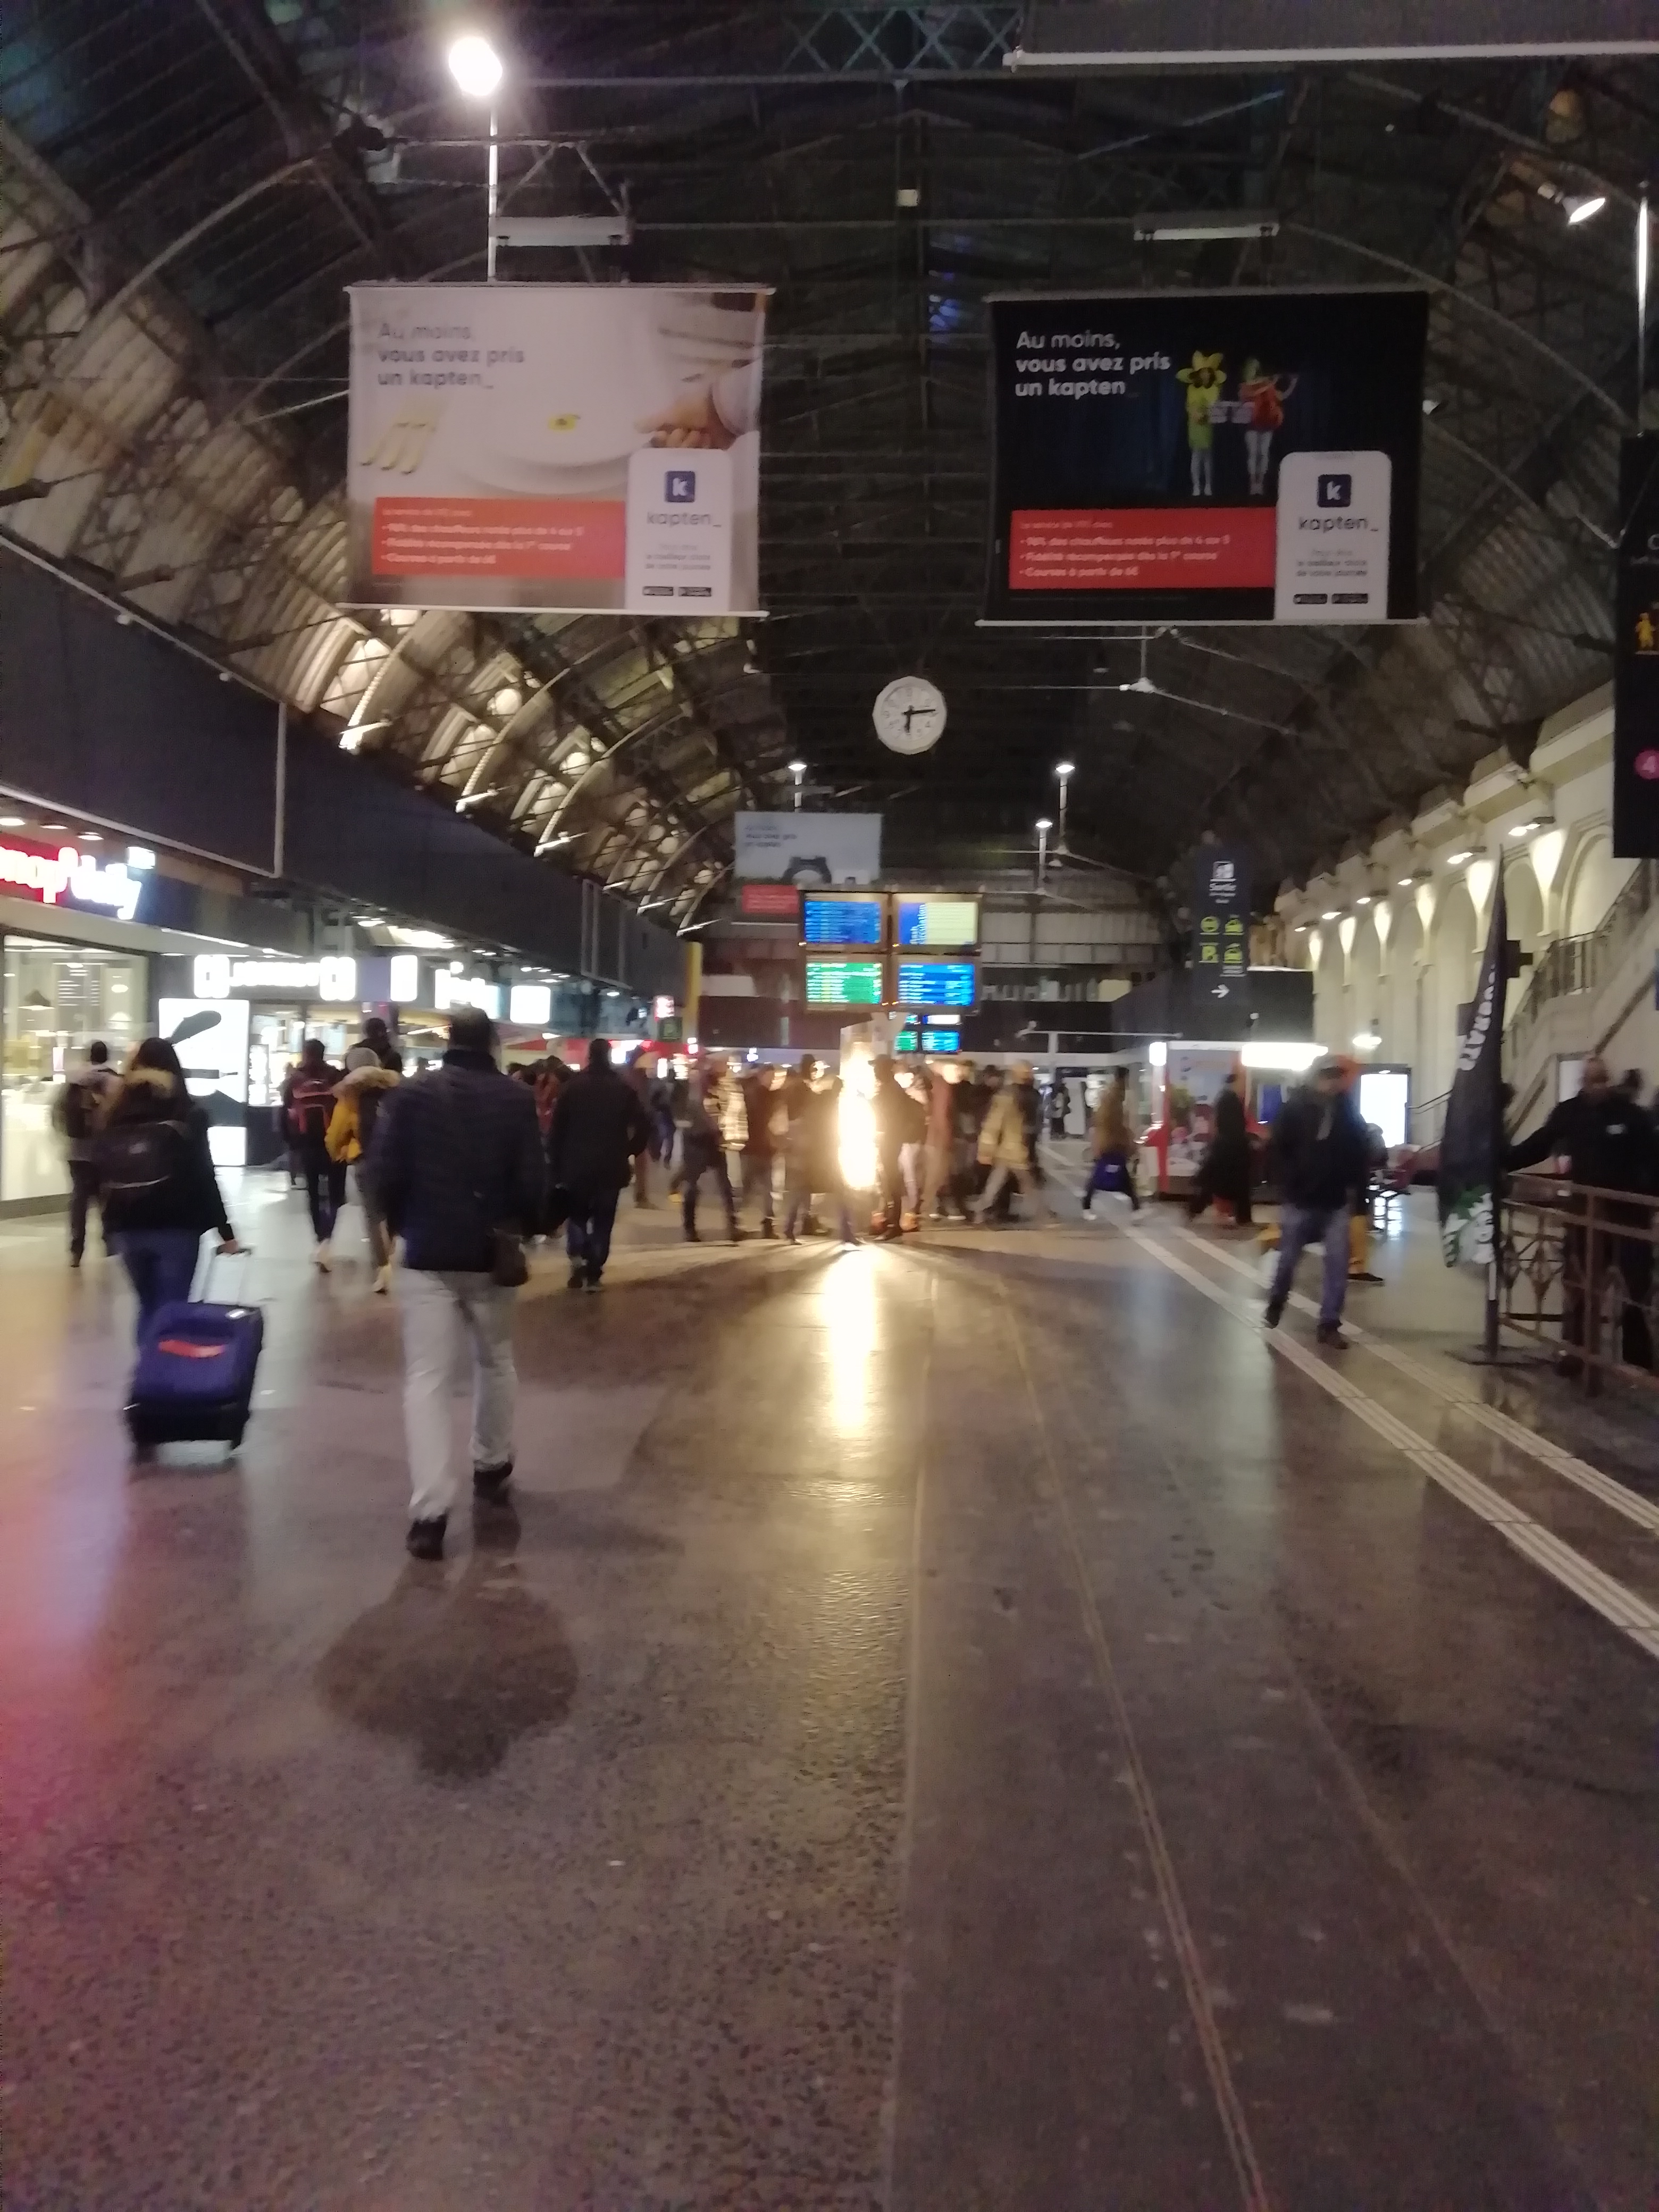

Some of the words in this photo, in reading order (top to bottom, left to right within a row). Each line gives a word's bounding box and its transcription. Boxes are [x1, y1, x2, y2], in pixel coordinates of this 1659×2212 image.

[377, 323, 404, 339] Au
[1016, 330, 1045, 349] Au
[1051, 329, 1120, 350] moins,
[378, 349, 425, 363] vous
[431, 349, 480, 363] avez
[486, 346, 524, 367] pris
[1015, 358, 1067, 372] vous
[1072, 357, 1124, 372] avez
[1129, 351, 1171, 375] pris
[378, 373, 402, 386] un
[1015, 381, 1042, 396] un
